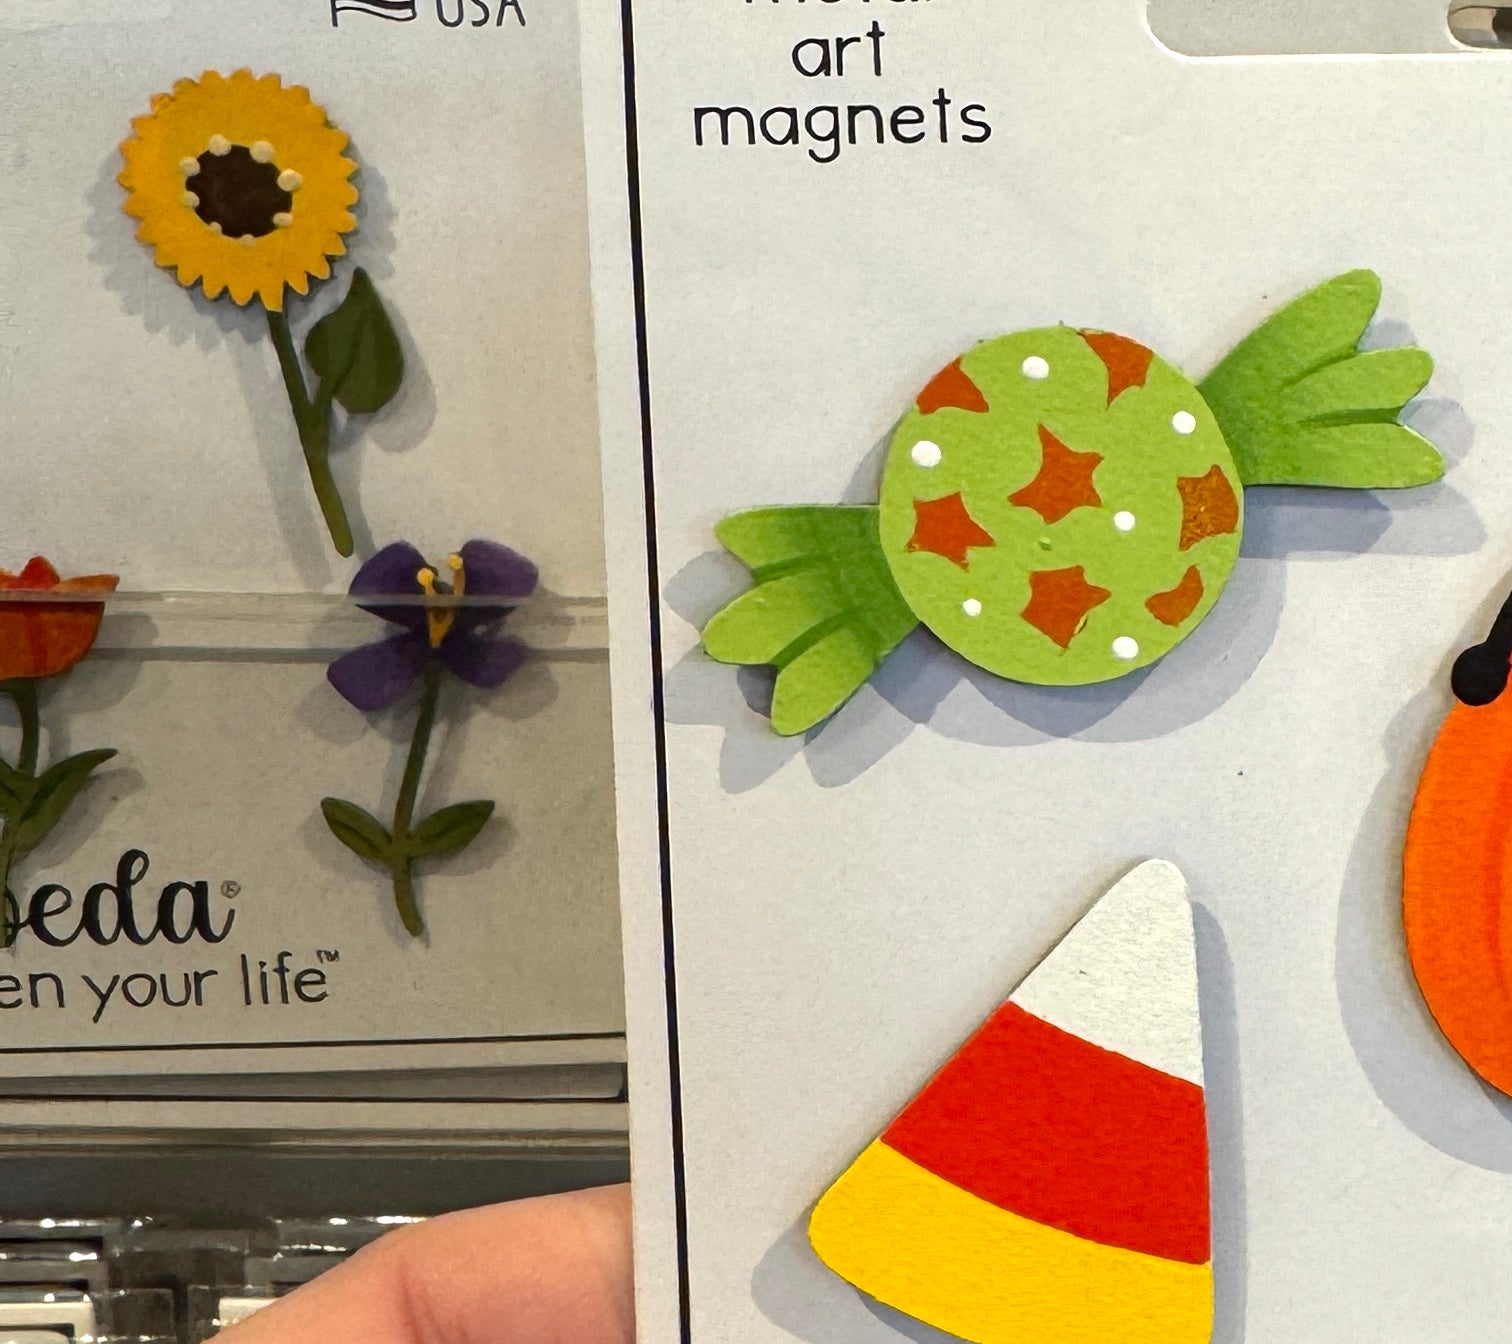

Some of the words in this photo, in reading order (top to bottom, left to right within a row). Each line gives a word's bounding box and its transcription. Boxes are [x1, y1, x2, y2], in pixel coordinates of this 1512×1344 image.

[792, 20, 886, 77] art
[693, 87, 992, 164] magnets
[81, 969, 219, 1024] your
